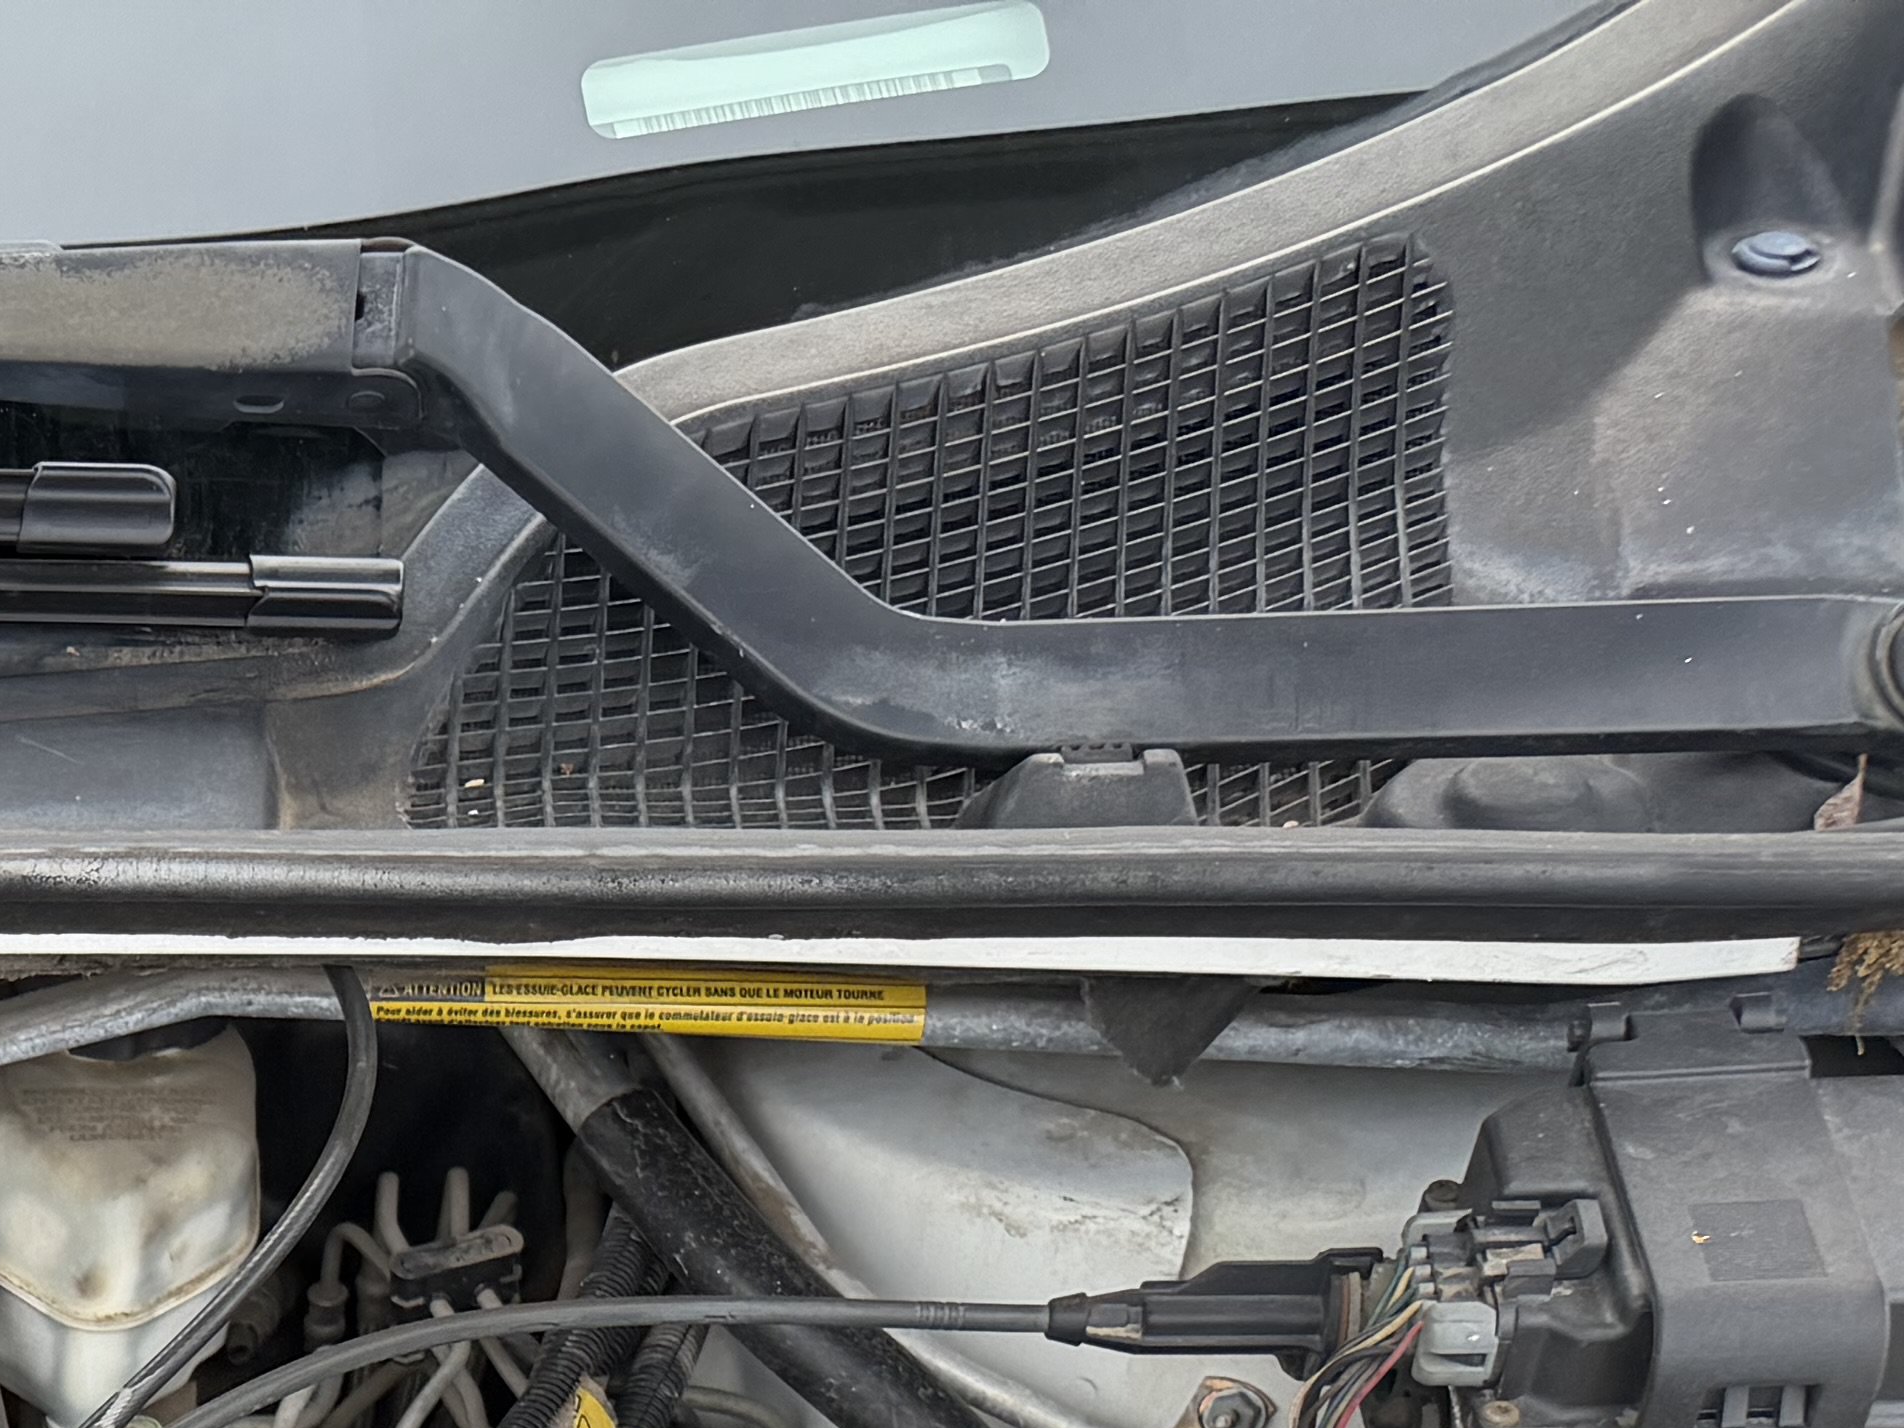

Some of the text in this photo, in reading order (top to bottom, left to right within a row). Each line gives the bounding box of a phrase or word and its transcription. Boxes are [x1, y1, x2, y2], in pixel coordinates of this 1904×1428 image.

[705, 987, 736, 998] SANS
[739, 987, 762, 998] QUE
[766, 988, 779, 998] LE
[783, 988, 832, 999] MOTEUR
